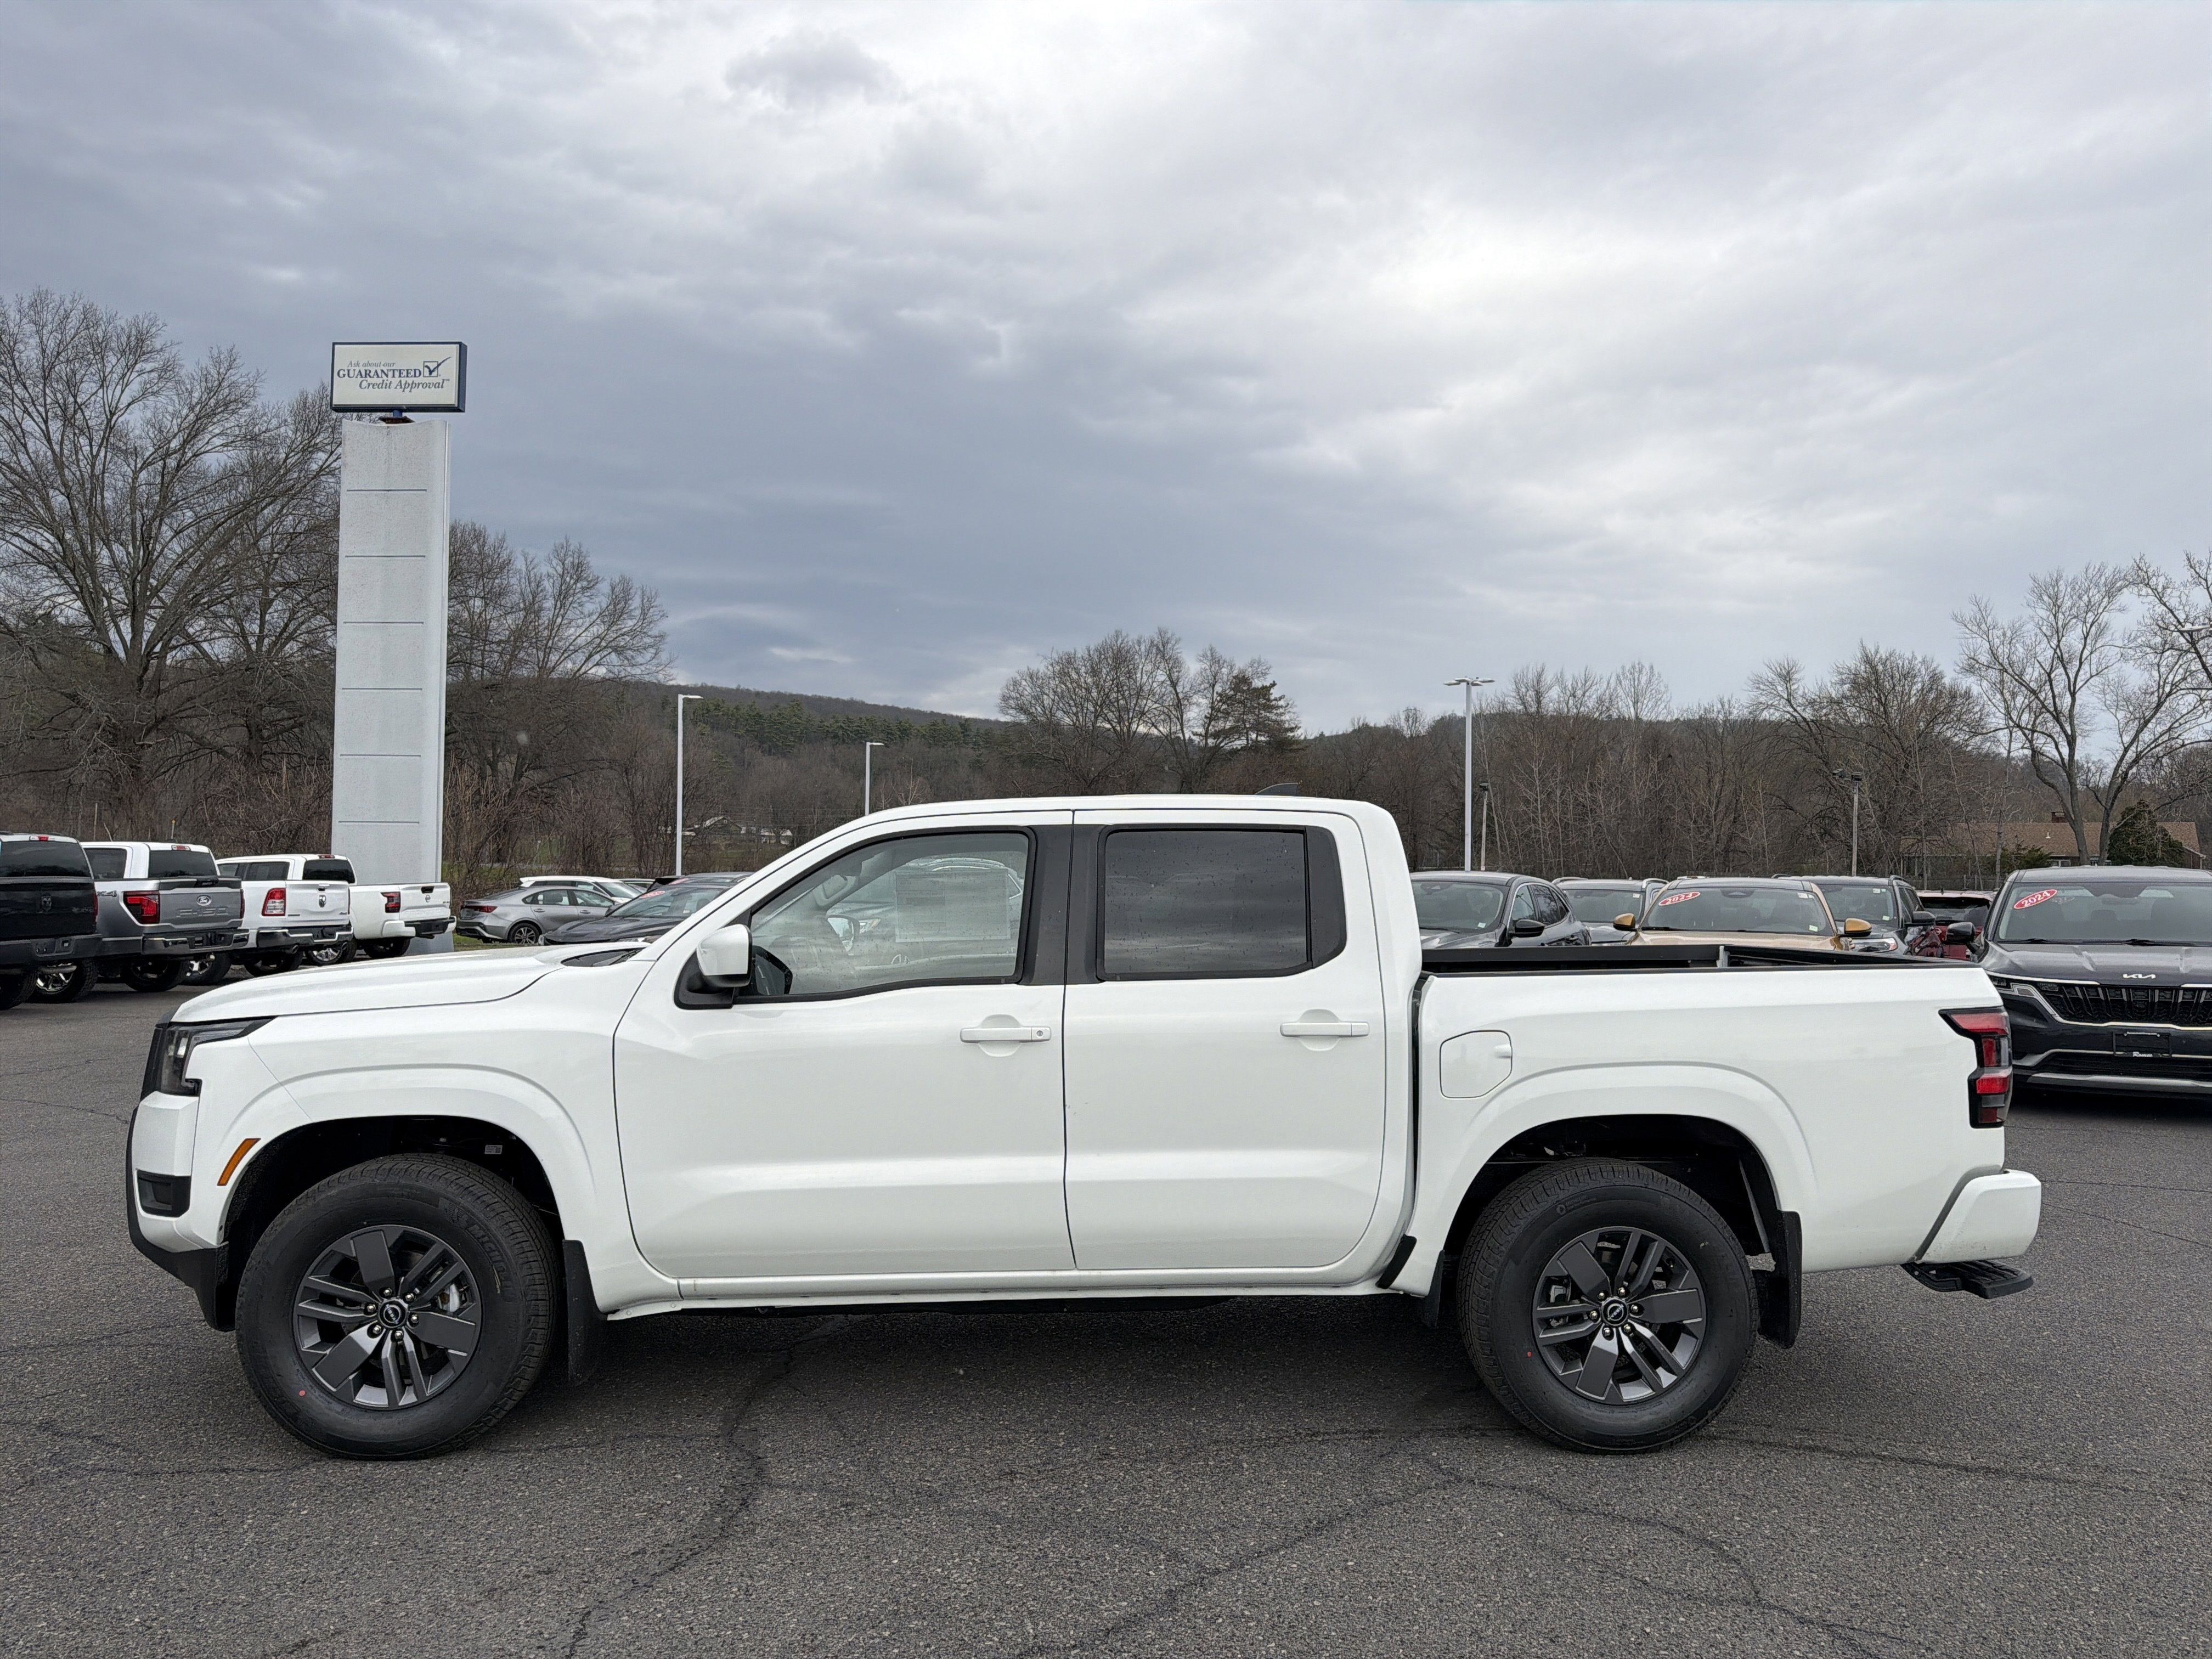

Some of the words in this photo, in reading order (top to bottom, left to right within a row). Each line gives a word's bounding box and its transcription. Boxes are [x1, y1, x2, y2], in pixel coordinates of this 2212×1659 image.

[337, 368, 422, 379] GUARANTEED
[359, 379, 393, 390] Credit
[1667, 893, 1693, 904] 2024
[2022, 890, 2051, 906] 2024
